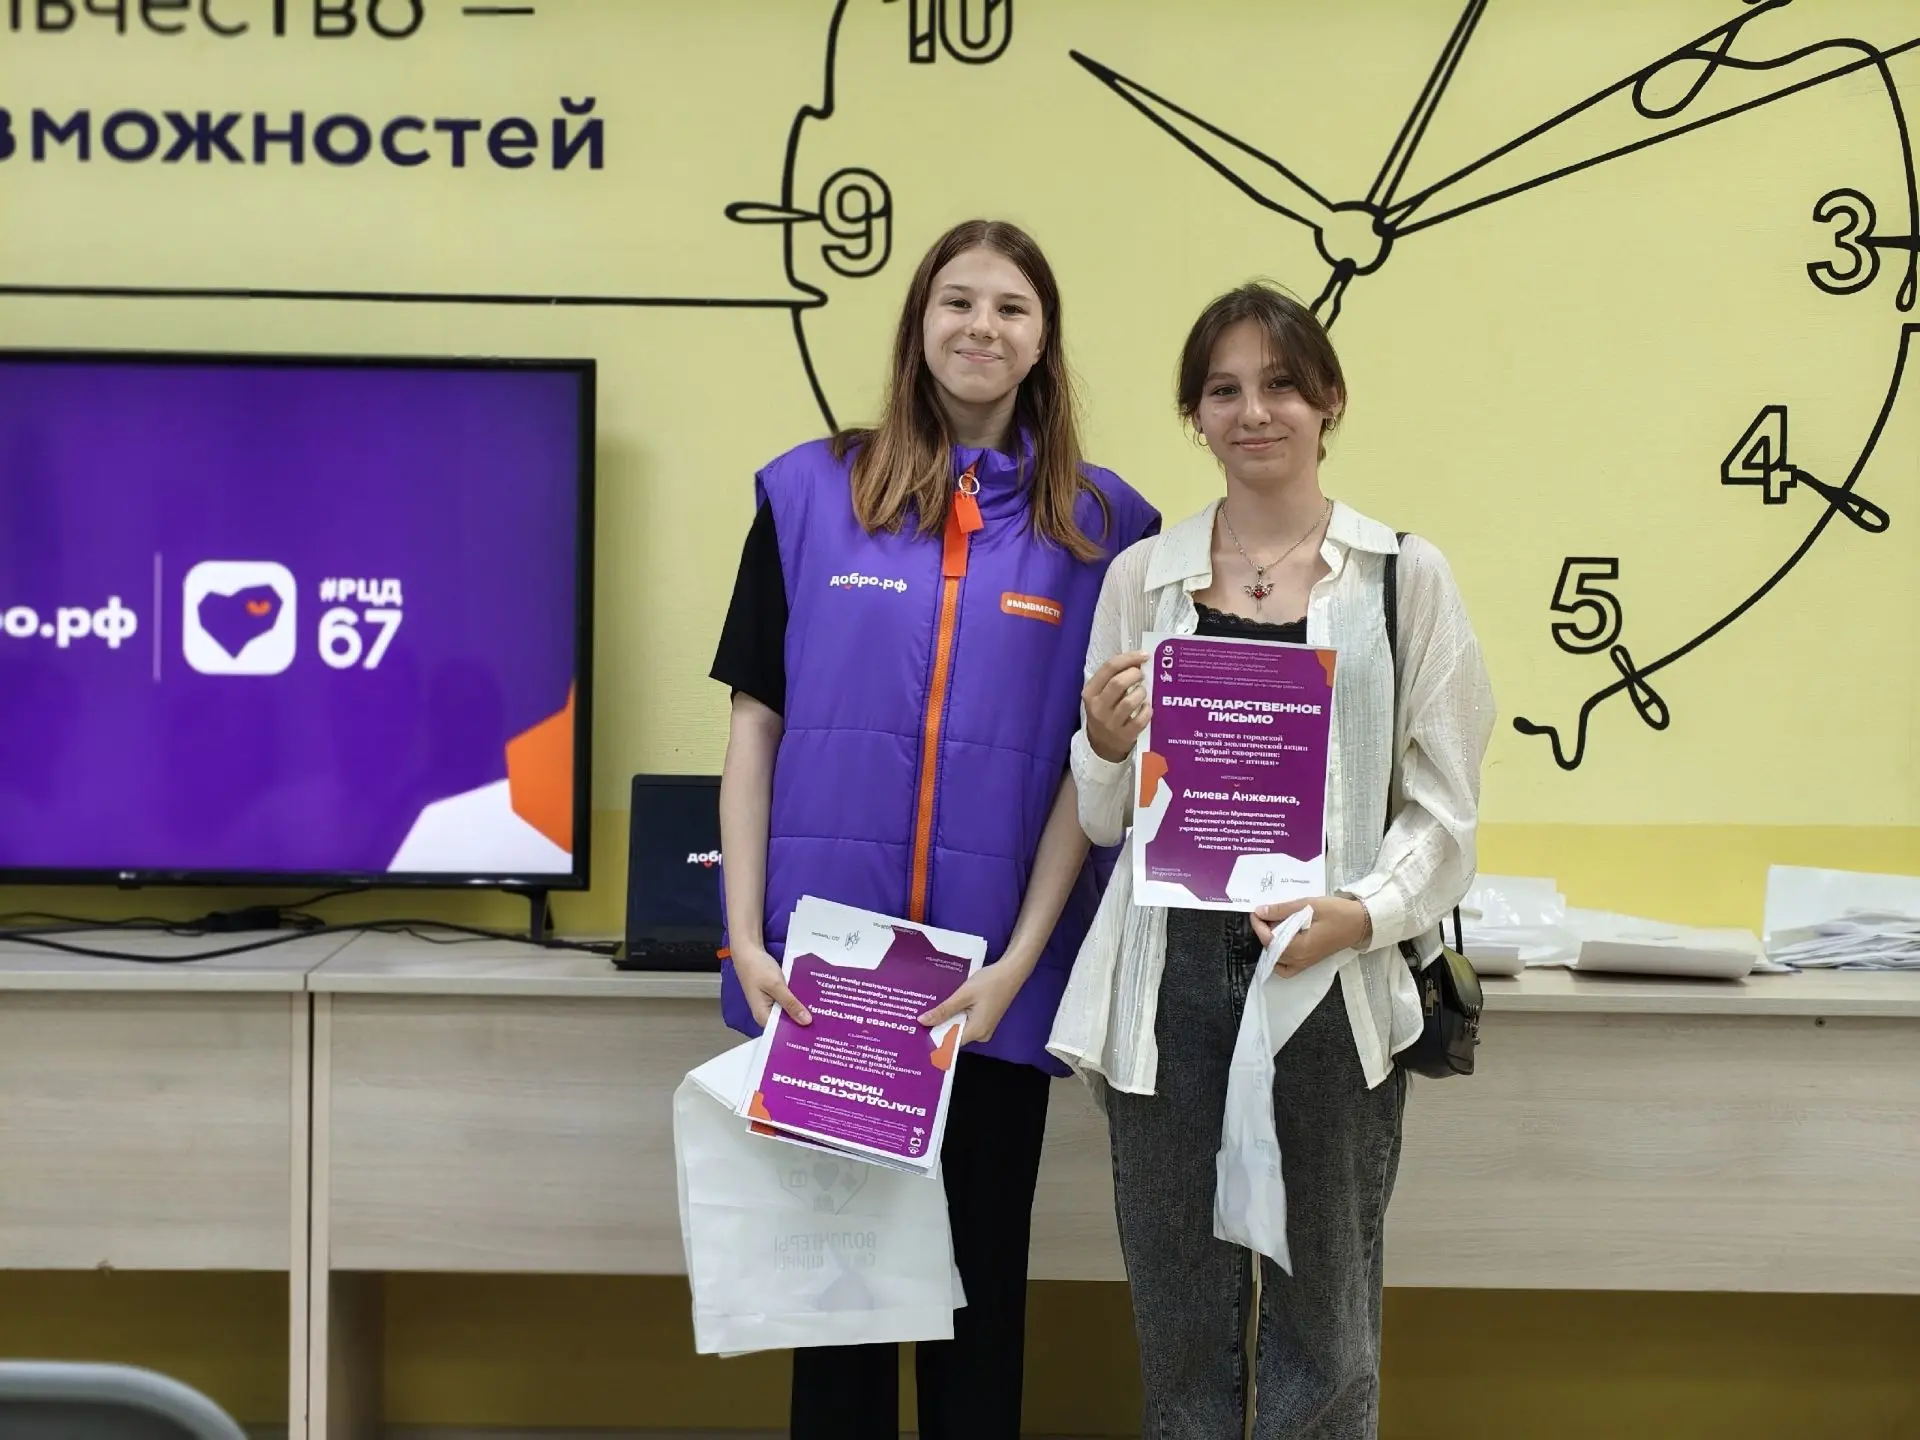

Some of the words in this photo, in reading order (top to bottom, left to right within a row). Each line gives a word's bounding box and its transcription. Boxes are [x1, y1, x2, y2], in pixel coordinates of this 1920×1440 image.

[818, 166, 893, 278] 9
[1806, 187, 1880, 295] 3
[1721, 404, 1798, 504] 4
[319, 577, 403, 606] #РЦД
[830, 572, 908, 593] добро.рф
[1549, 556, 1623, 655] 5
[318, 608, 403, 669] 67
[1162, 696, 1321, 715] БЛАГОДАРСТВЕННОЕ
[1208, 712, 1274, 725] ПИСЬМО
[1194, 729, 1203, 738] За
[1204, 732, 1235, 740] участие
[1243, 733, 1283, 743] городской
[1195, 755, 1237, 765] волонтеры
[1183, 789, 1229, 801] Алиева
[1232, 791, 1300, 807] Анжелика,
[1184, 816, 1225, 825] бюджетного
[1226, 818, 1285, 828] образовательного
[1230, 809, 1285, 819] Муниципального
[1178, 825, 1218, 834] учреждения
[1194, 834, 1239, 843] руководитель
[806, 1004, 864, 1024] Виктория,
[819, 997, 872, 1013] Муниципального
[866, 1018, 916, 1035] Богачева
[772, 1073, 926, 1116] БЛАГОДАРСТВЕННОЕ
[820, 1075, 884, 1096] ПИСЬМО
